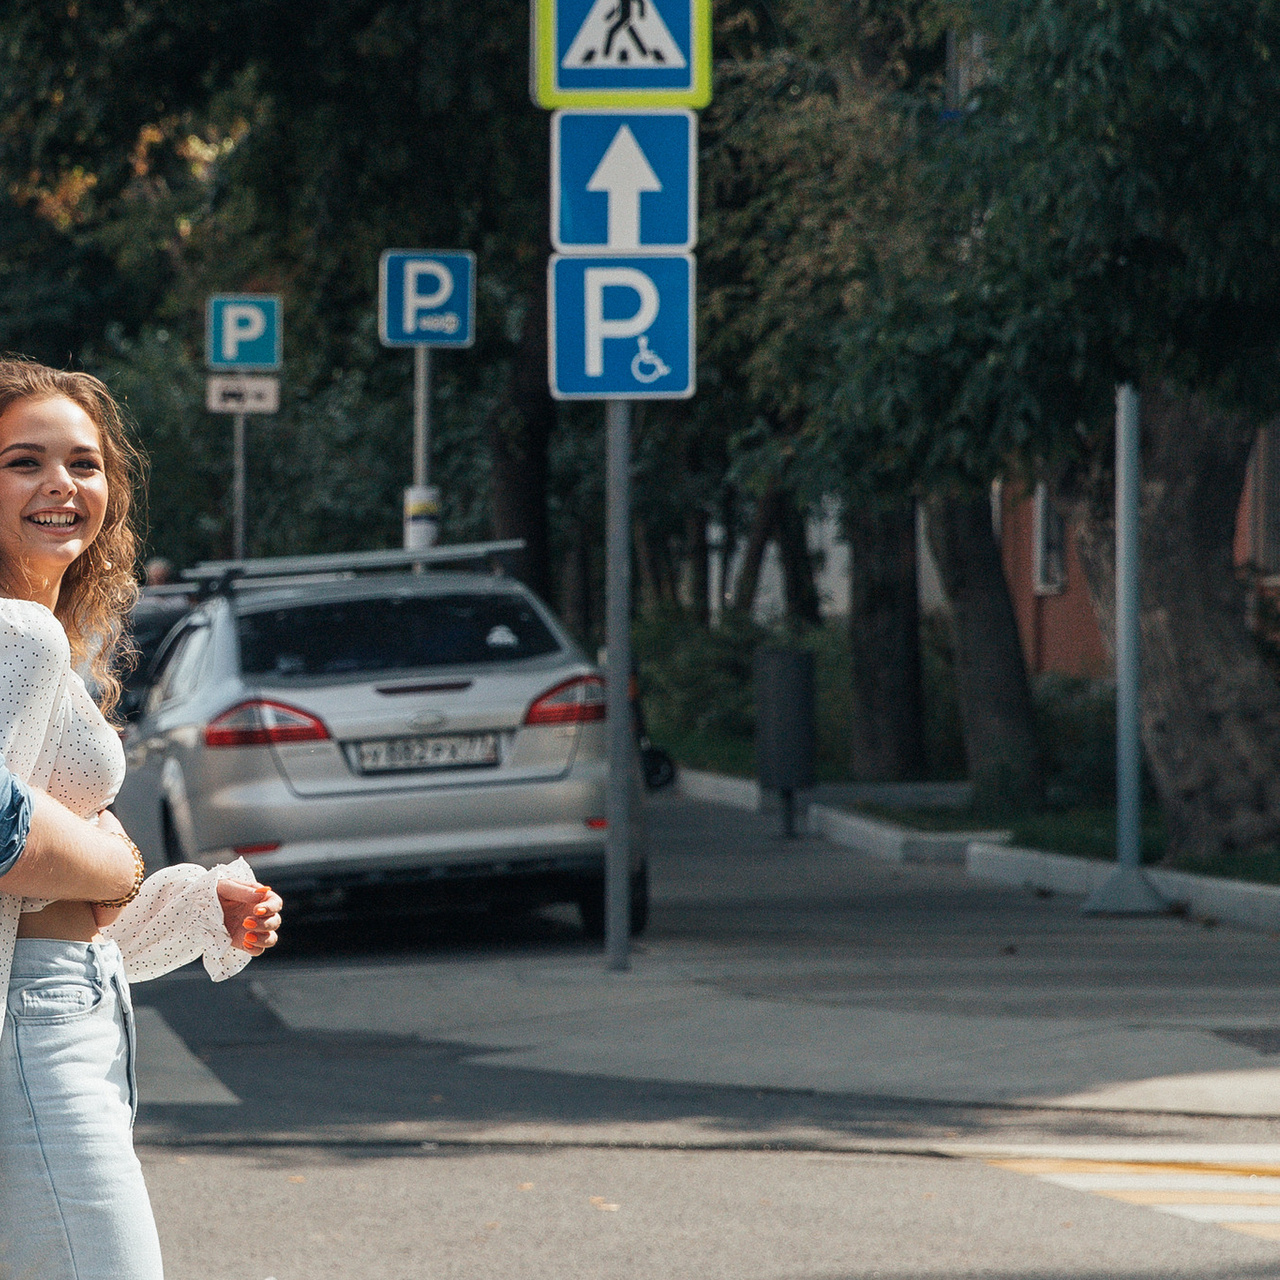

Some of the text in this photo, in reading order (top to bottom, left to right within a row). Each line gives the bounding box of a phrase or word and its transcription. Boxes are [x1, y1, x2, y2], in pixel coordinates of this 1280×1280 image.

[222, 304, 266, 360] P
[403, 259, 454, 334] P
[584, 267, 660, 378] P
